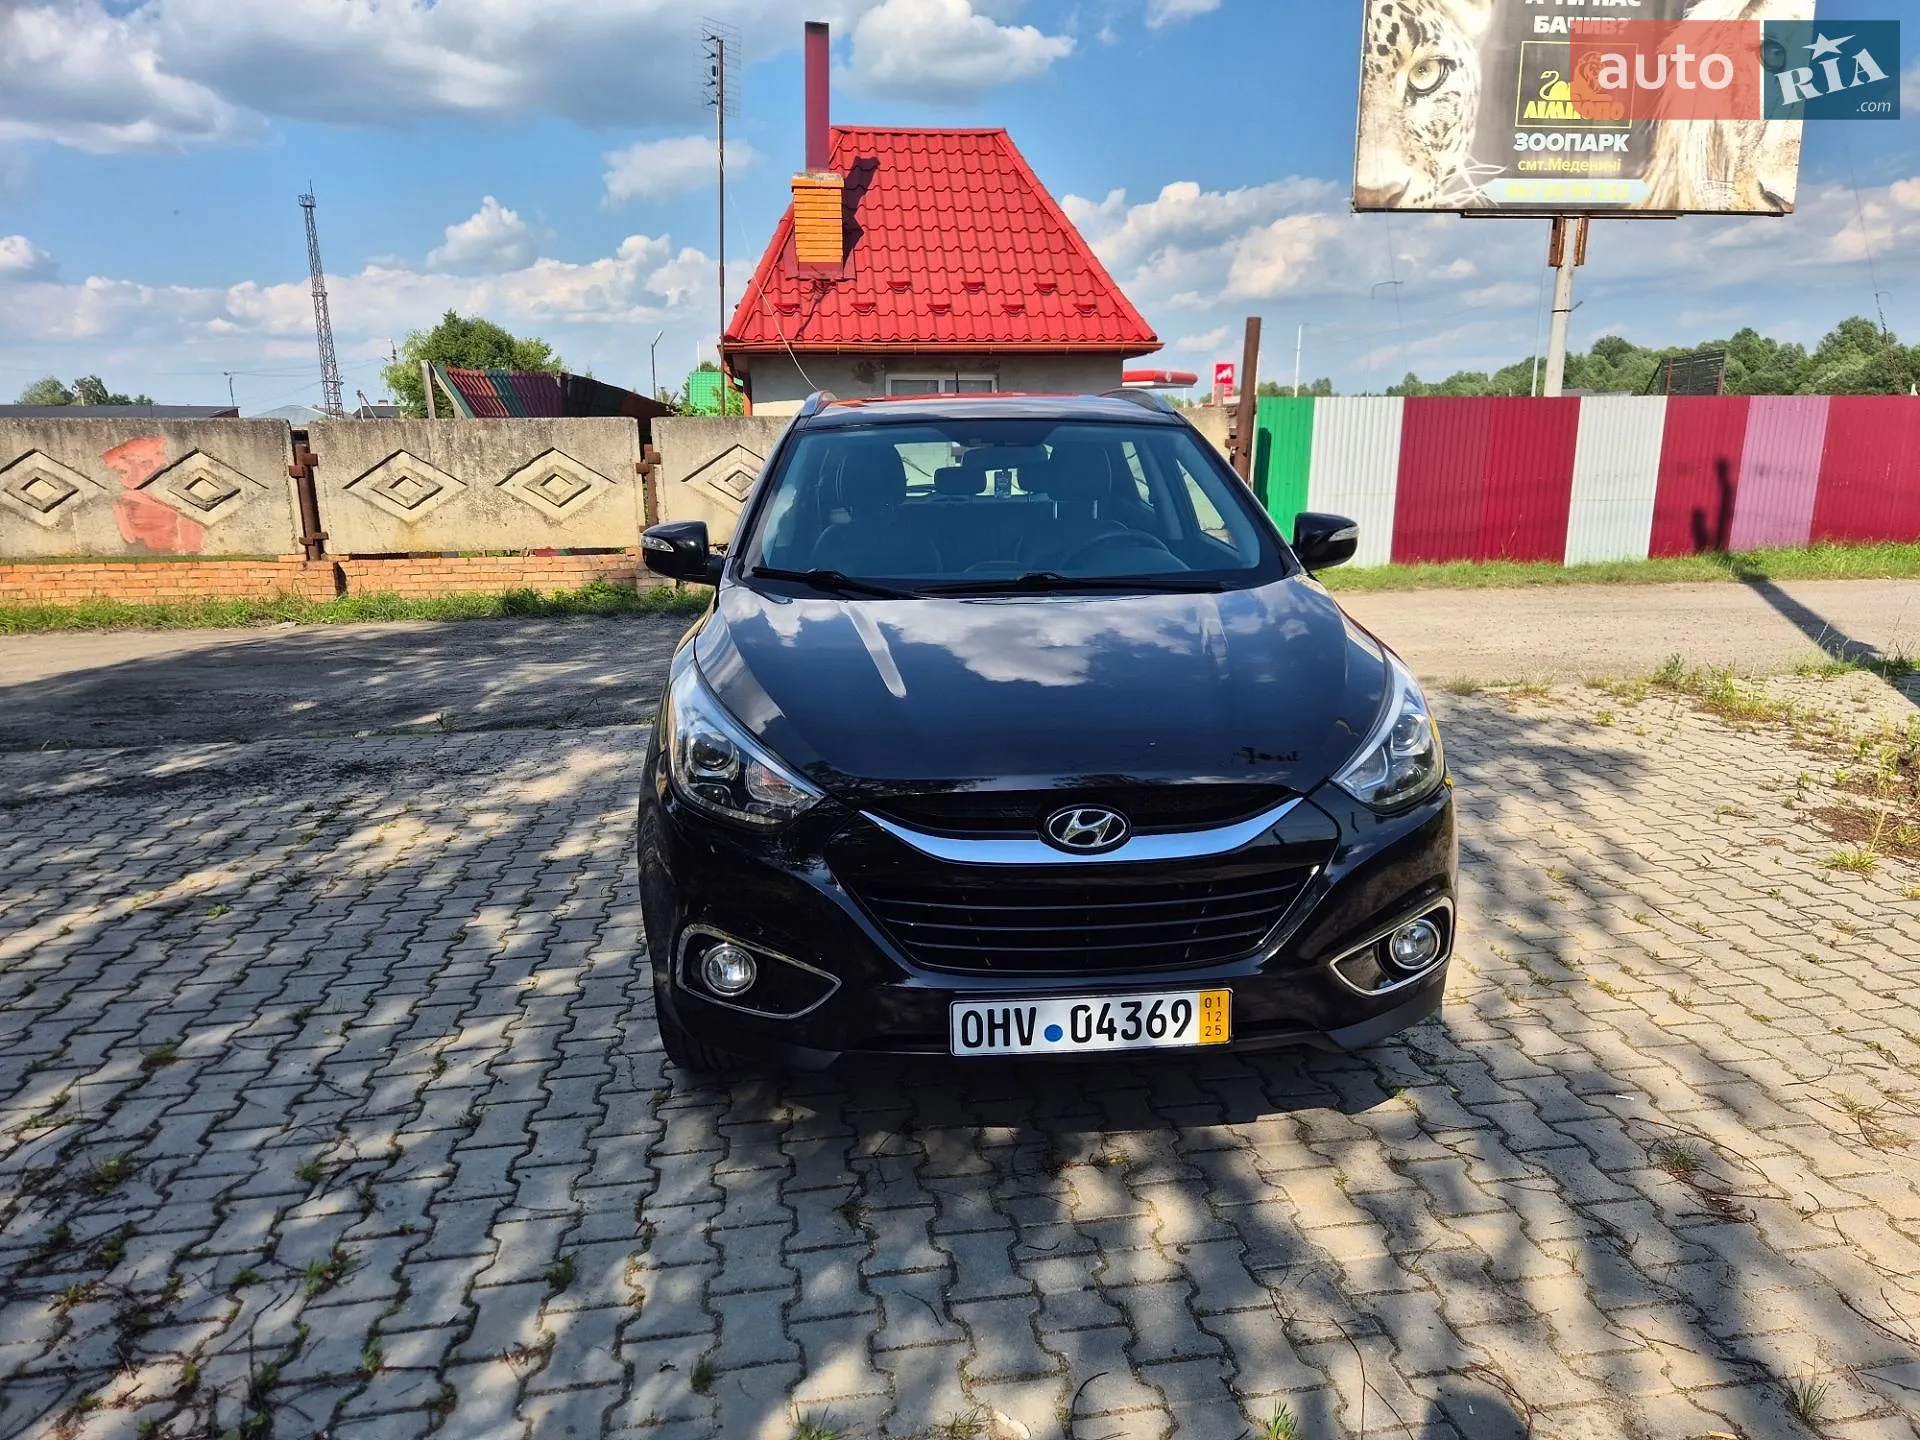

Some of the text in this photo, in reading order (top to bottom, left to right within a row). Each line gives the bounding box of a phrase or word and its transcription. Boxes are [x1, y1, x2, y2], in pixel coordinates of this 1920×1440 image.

[1533, 15, 1631, 35] БАЧИВ?
[1513, 132, 1630, 152] ЗООПАРК
[1204, 996, 1221, 1008] 01
[961, 999, 1192, 1048] OHV 04369
[1206, 1011, 1222, 1022] 12
[1204, 1025, 1222, 1037] 25
